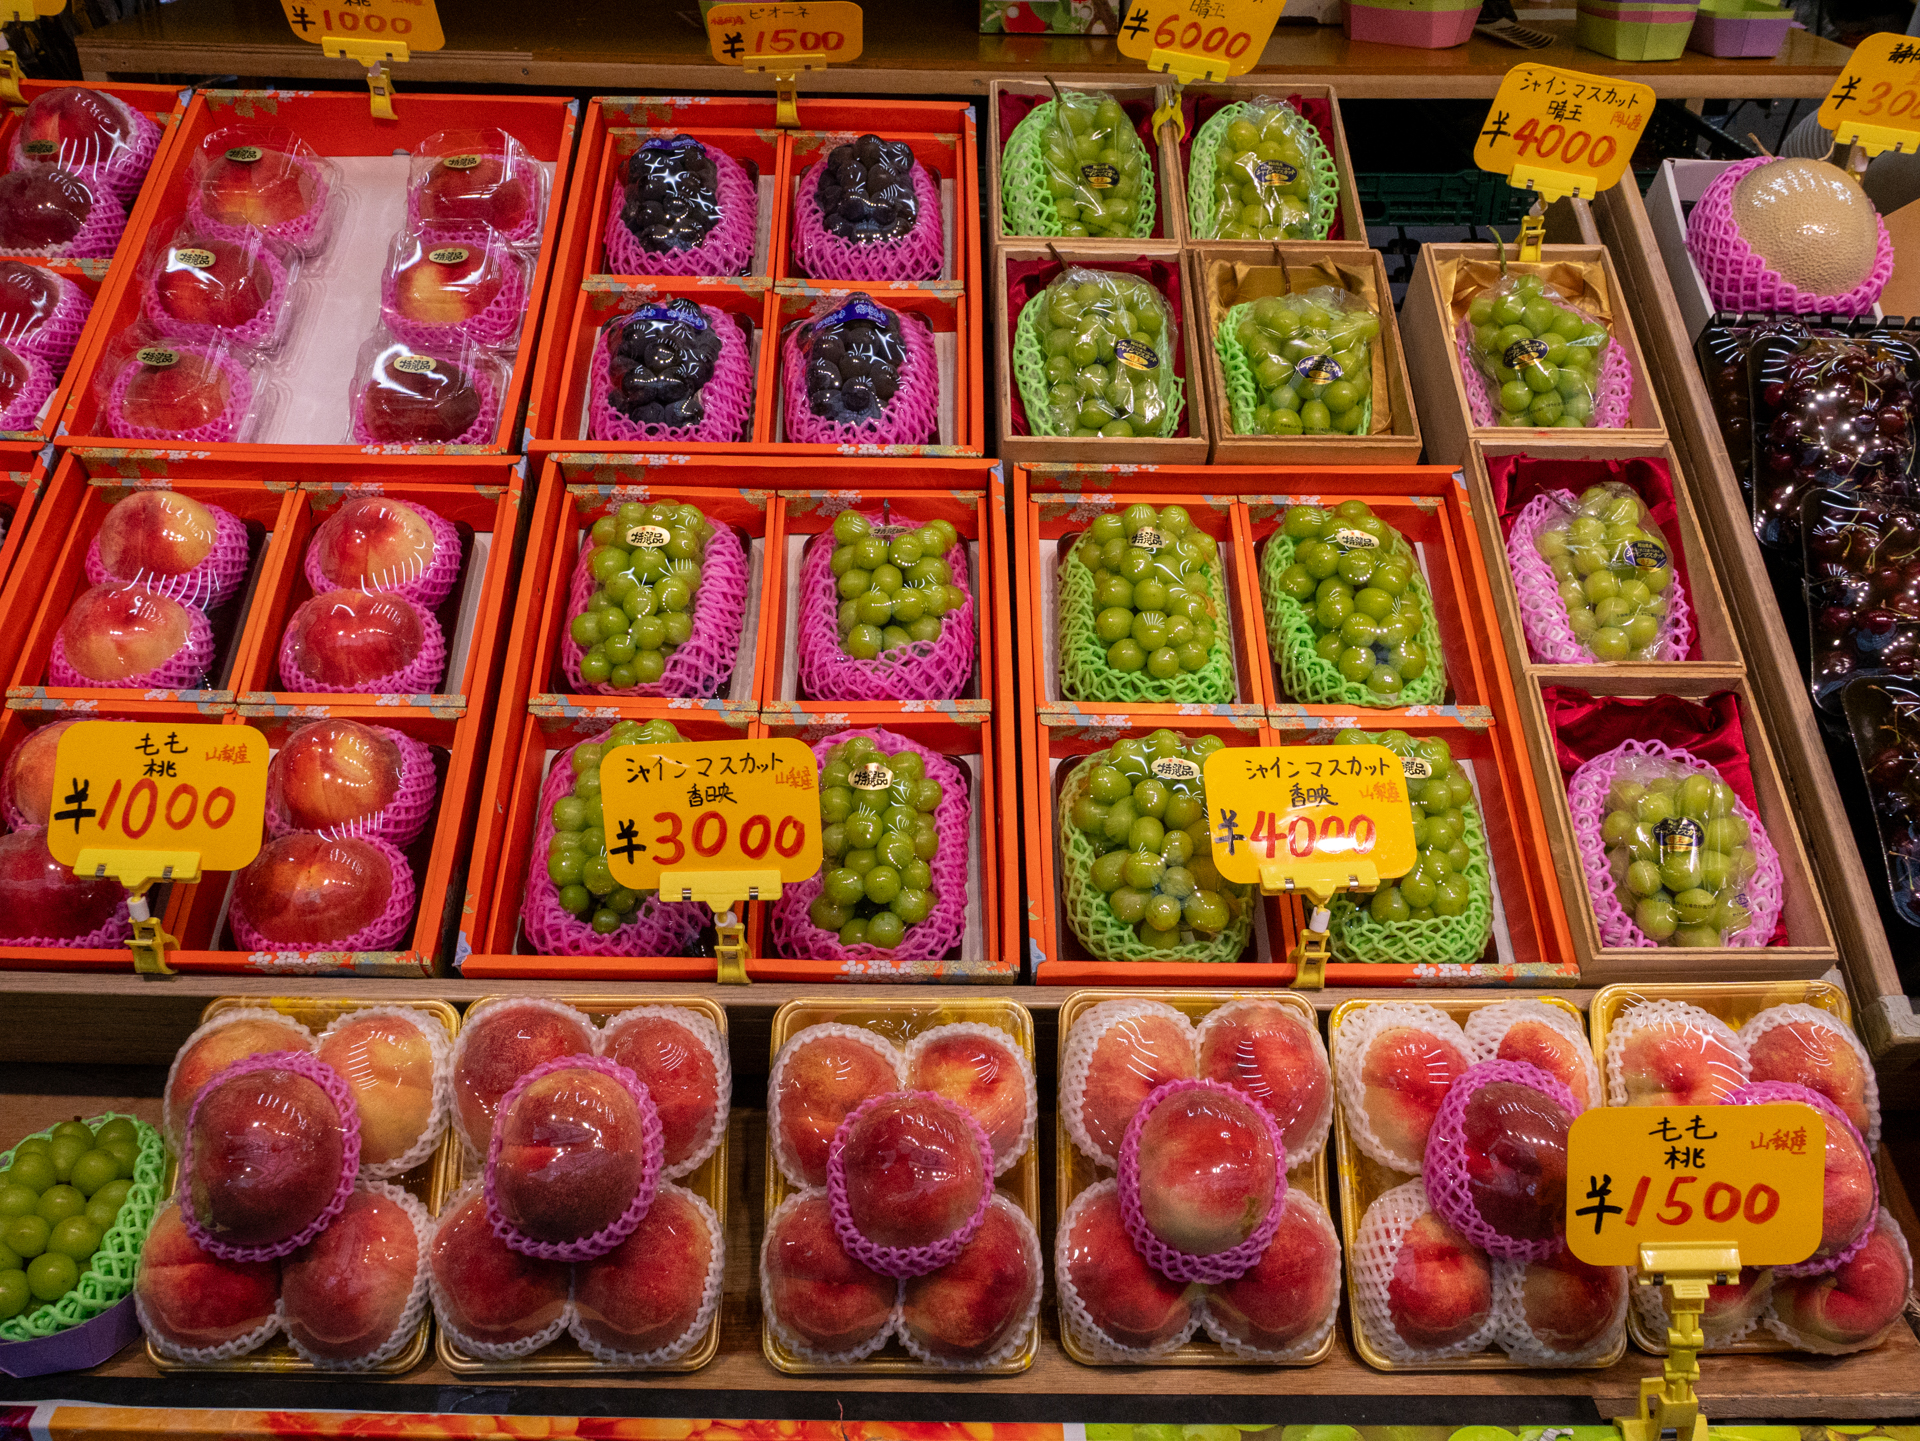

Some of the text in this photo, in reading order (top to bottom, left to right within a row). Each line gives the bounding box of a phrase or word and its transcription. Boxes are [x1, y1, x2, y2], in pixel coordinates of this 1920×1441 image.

[291, 6, 413, 34] ¥1000
[750, 6, 810, 19] ピオーネ
[722, 29, 845, 59] ¥1500
[1123, 8, 1252, 59] ¥6000
[1519, 71, 1639, 109] シャインマスカット
[1546, 100, 1583, 123] 晴王
[1482, 110, 1618, 168] ¥4000
[631, 531, 664, 545] 特選品
[1131, 532, 1162, 546] 特選品
[1342, 535, 1375, 548] 特選品
[205, 743, 251, 765] 山梨産
[142, 758, 178, 778] 桃
[625, 752, 784, 783] シャインマスカット
[774, 766, 815, 791] 山梨産
[854, 770, 888, 787] 特選品
[1157, 763, 1193, 777] 特選品
[1244, 756, 1391, 780] シャインマスカット
[1401, 761, 1426, 775] 選品
[1359, 779, 1403, 804] 山梨産
[54, 777, 237, 840] ¥1000
[609, 810, 806, 866] ¥3000
[1750, 1126, 1808, 1155] 山梨産
[1664, 1145, 1706, 1169] 桃
[1575, 1174, 1781, 1235] ¥1500
